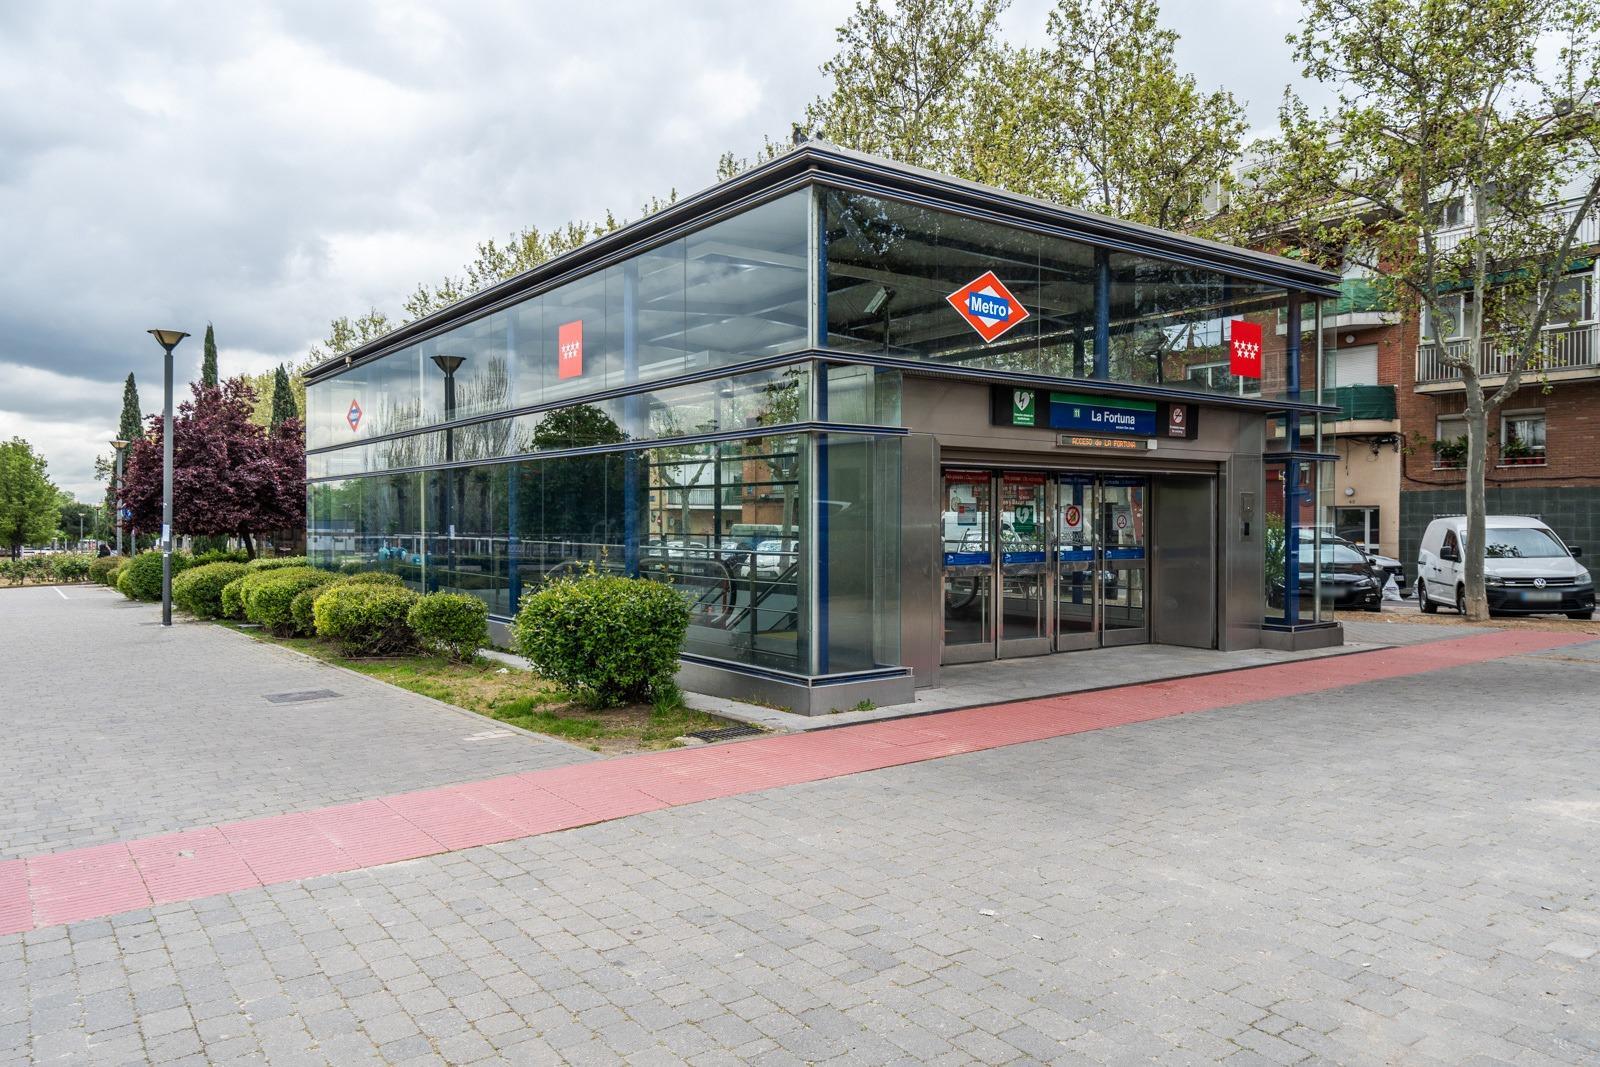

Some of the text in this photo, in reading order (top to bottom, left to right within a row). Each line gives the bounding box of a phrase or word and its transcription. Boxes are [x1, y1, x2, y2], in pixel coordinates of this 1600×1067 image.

[971, 296, 1007, 317] Metro
[1091, 410, 1135, 424] La Fortuna
[1072, 437, 1092, 446] ACCESO
[1113, 440, 1136, 448] FORTUNA
